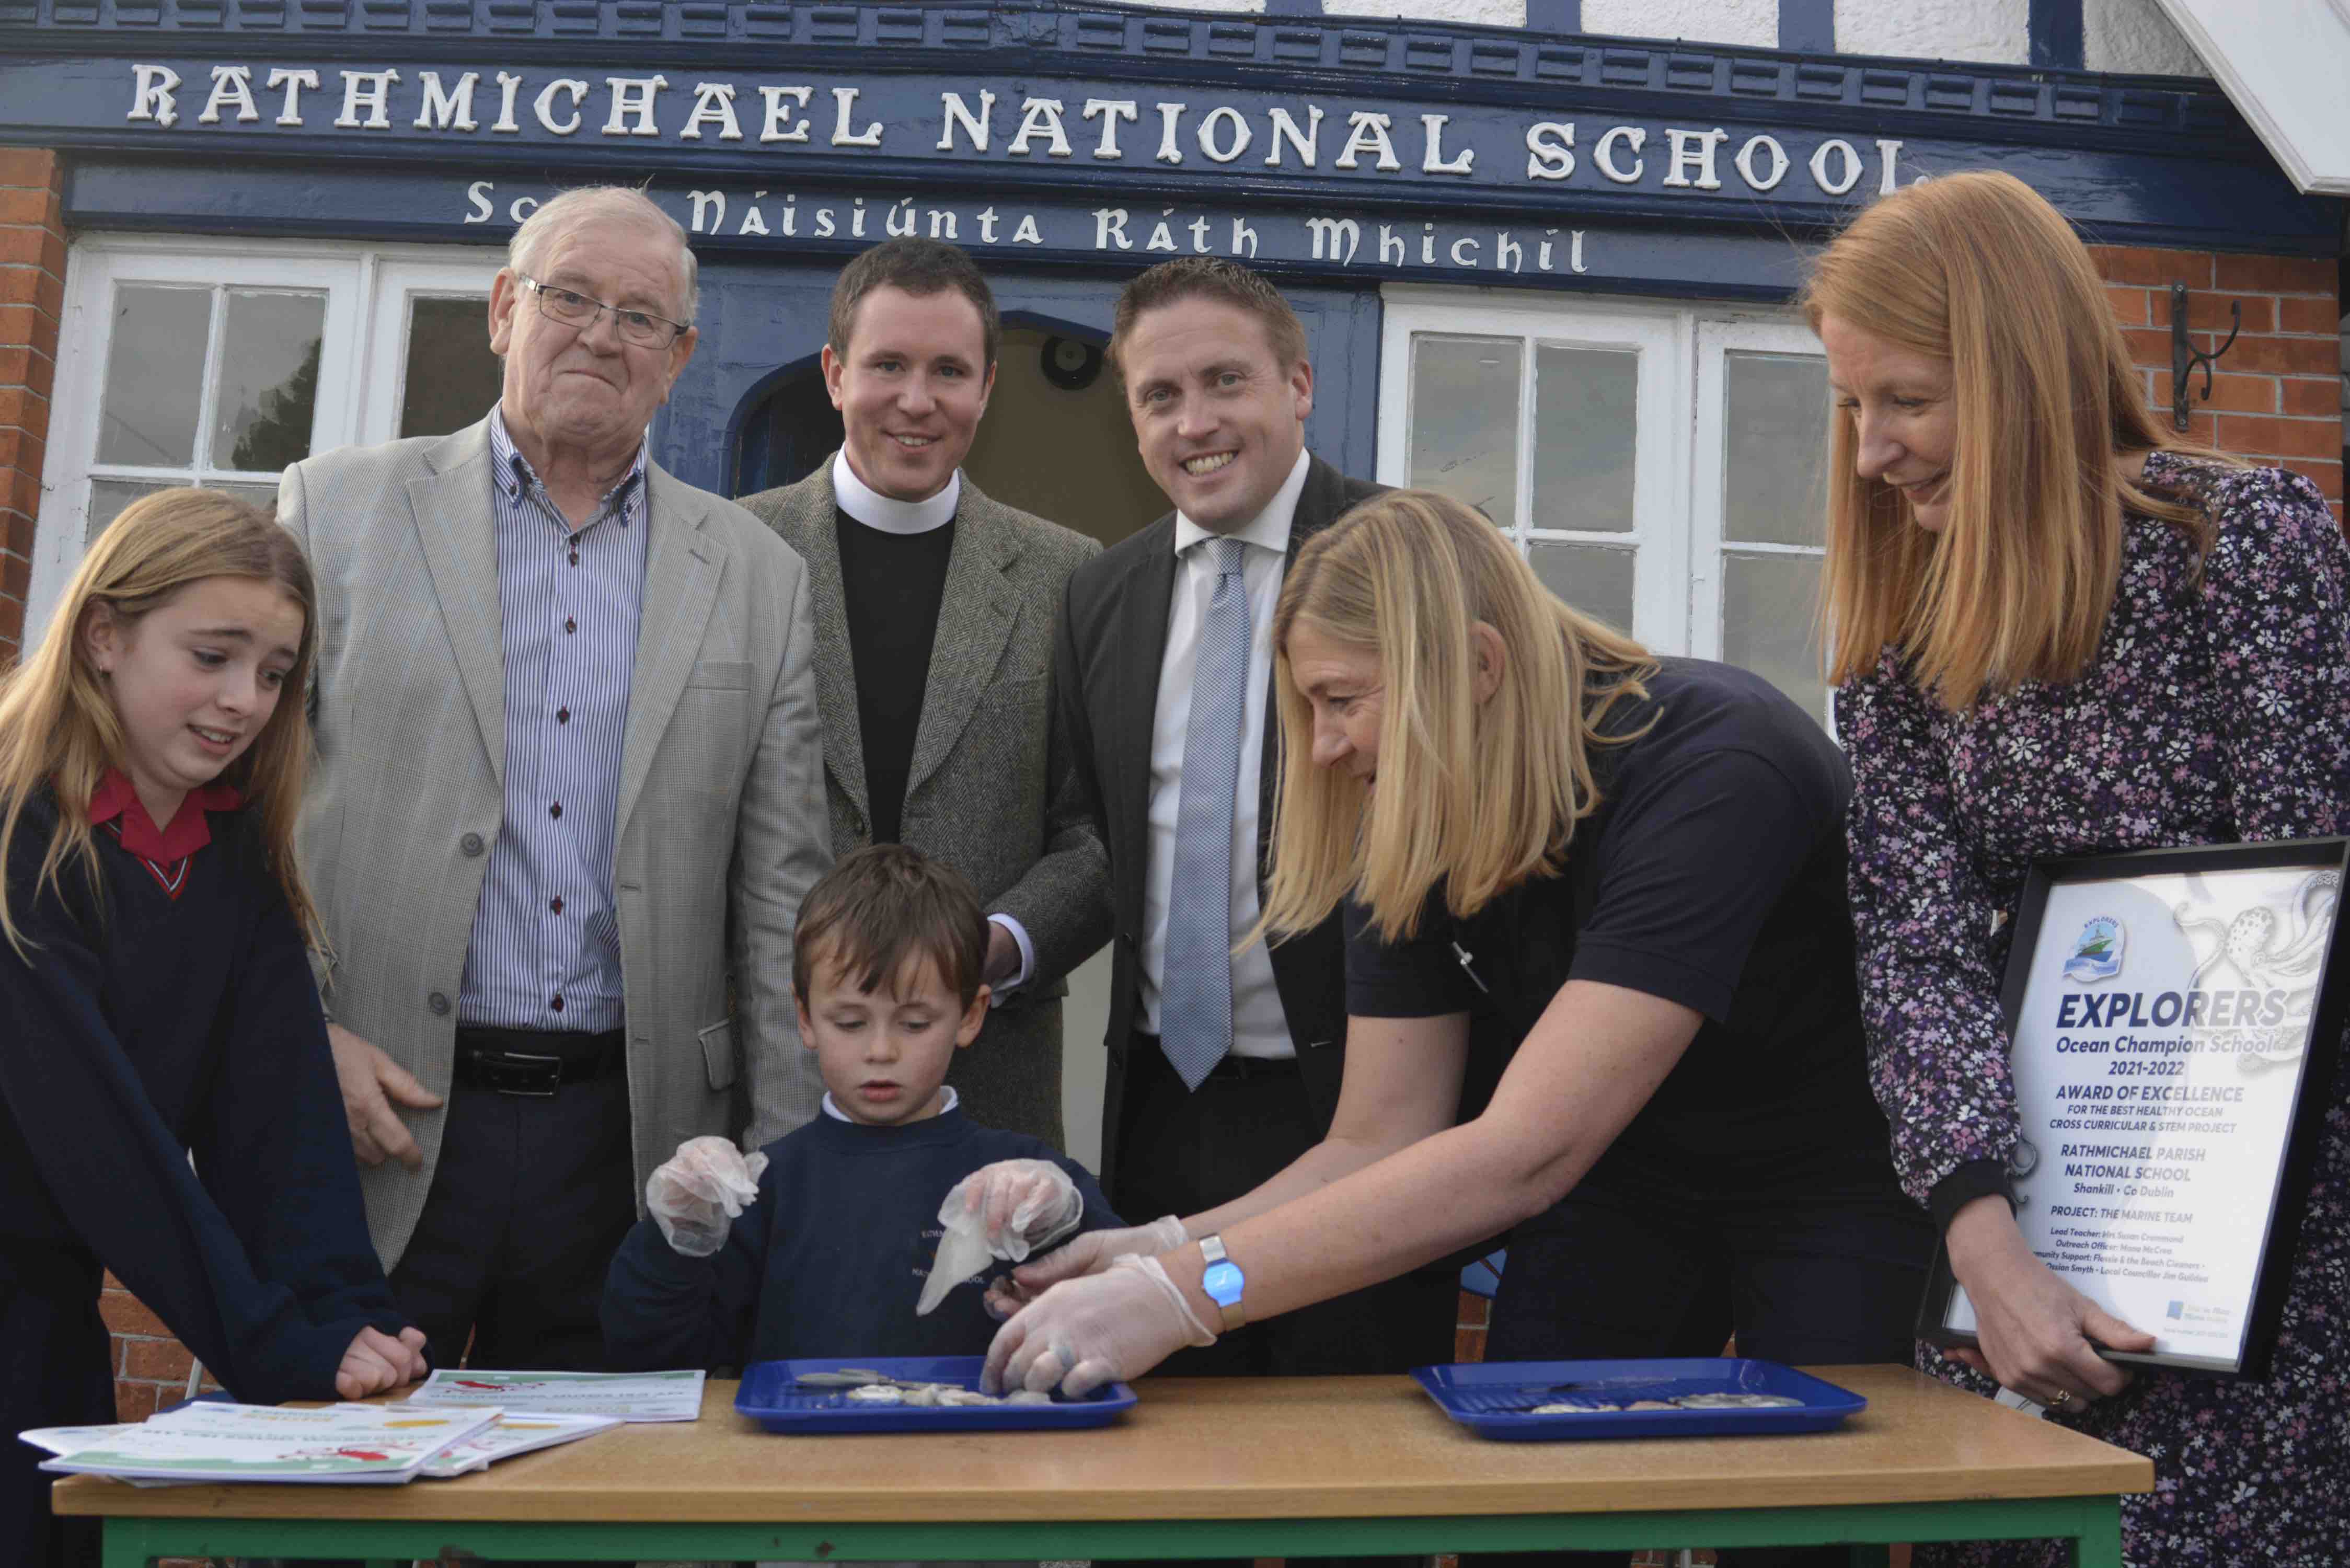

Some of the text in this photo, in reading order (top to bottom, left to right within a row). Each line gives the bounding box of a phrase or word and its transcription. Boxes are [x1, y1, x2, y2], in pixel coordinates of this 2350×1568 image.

[127, 64, 1930, 195] RATHMICHAEL NATIONAL SCHOOL
[687, 190, 1588, 273] Náisiúnta Ráth Mhichíl
[2056, 989, 2288, 1029] EXPLORERS
[2056, 1034, 2274, 1056] Ocean Champion School
[2108, 1061, 2185, 1076] 2021-2022
[2056, 1086, 2244, 1102] AWARD OF EXCELLENCE
[2067, 1104, 2224, 1117] FOR THE BEST HEALTHY OCEAN
[2049, 1119, 2238, 1134] CROSS CURRICULAR & STEM PROJECT
[2061, 1144, 2206, 1162] RATHMICHAEL PARISH
[2065, 1163, 2192, 1182] NATIONAL SCHOOL
[2073, 1182, 2174, 1198] Shankill Co Dublin
[2051, 1205, 2193, 1224] PROJECT: THE MARINE TEAM
[2050, 1227, 2068, 1236] Lead
[2070, 1228, 2101, 1238] Teacher:
[2056, 1239, 2089, 1249] Outreach
[2091, 1241, 2118, 1251] Officer:
[2061, 1252, 2091, 1263] Support:
